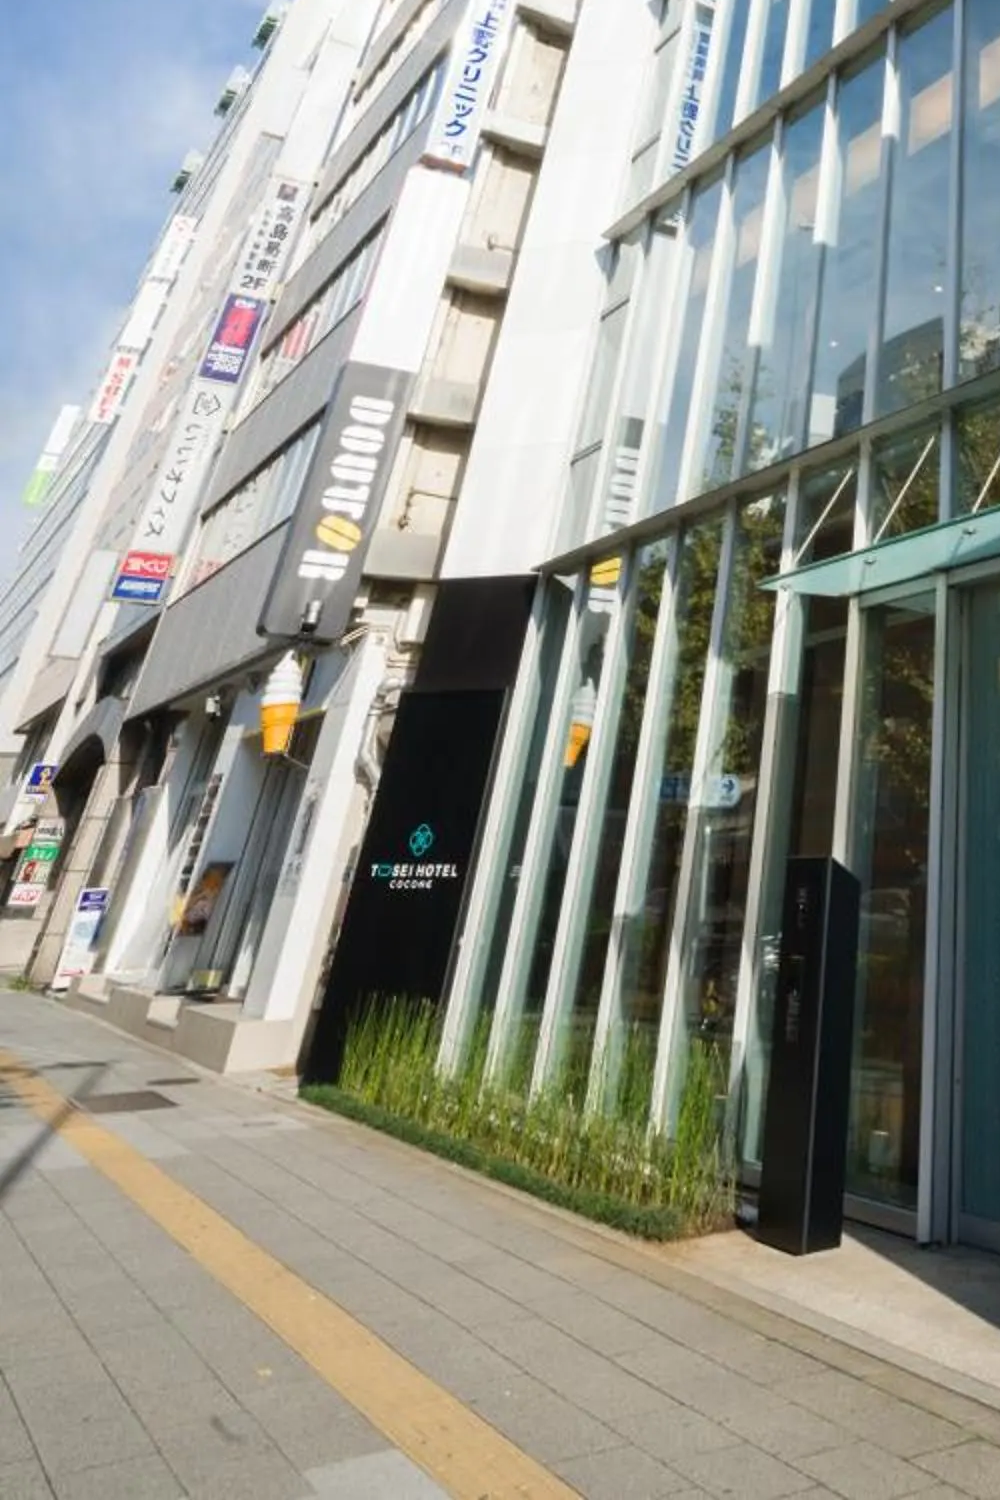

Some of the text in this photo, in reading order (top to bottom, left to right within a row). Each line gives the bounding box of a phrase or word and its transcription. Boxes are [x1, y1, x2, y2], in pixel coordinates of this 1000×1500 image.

[144, 424, 200, 538] いいオフィス
[298, 395, 394, 581] DOUTOR
[371, 863, 458, 878] TOSEI HOTEL
[389, 880, 433, 889] COCONE
